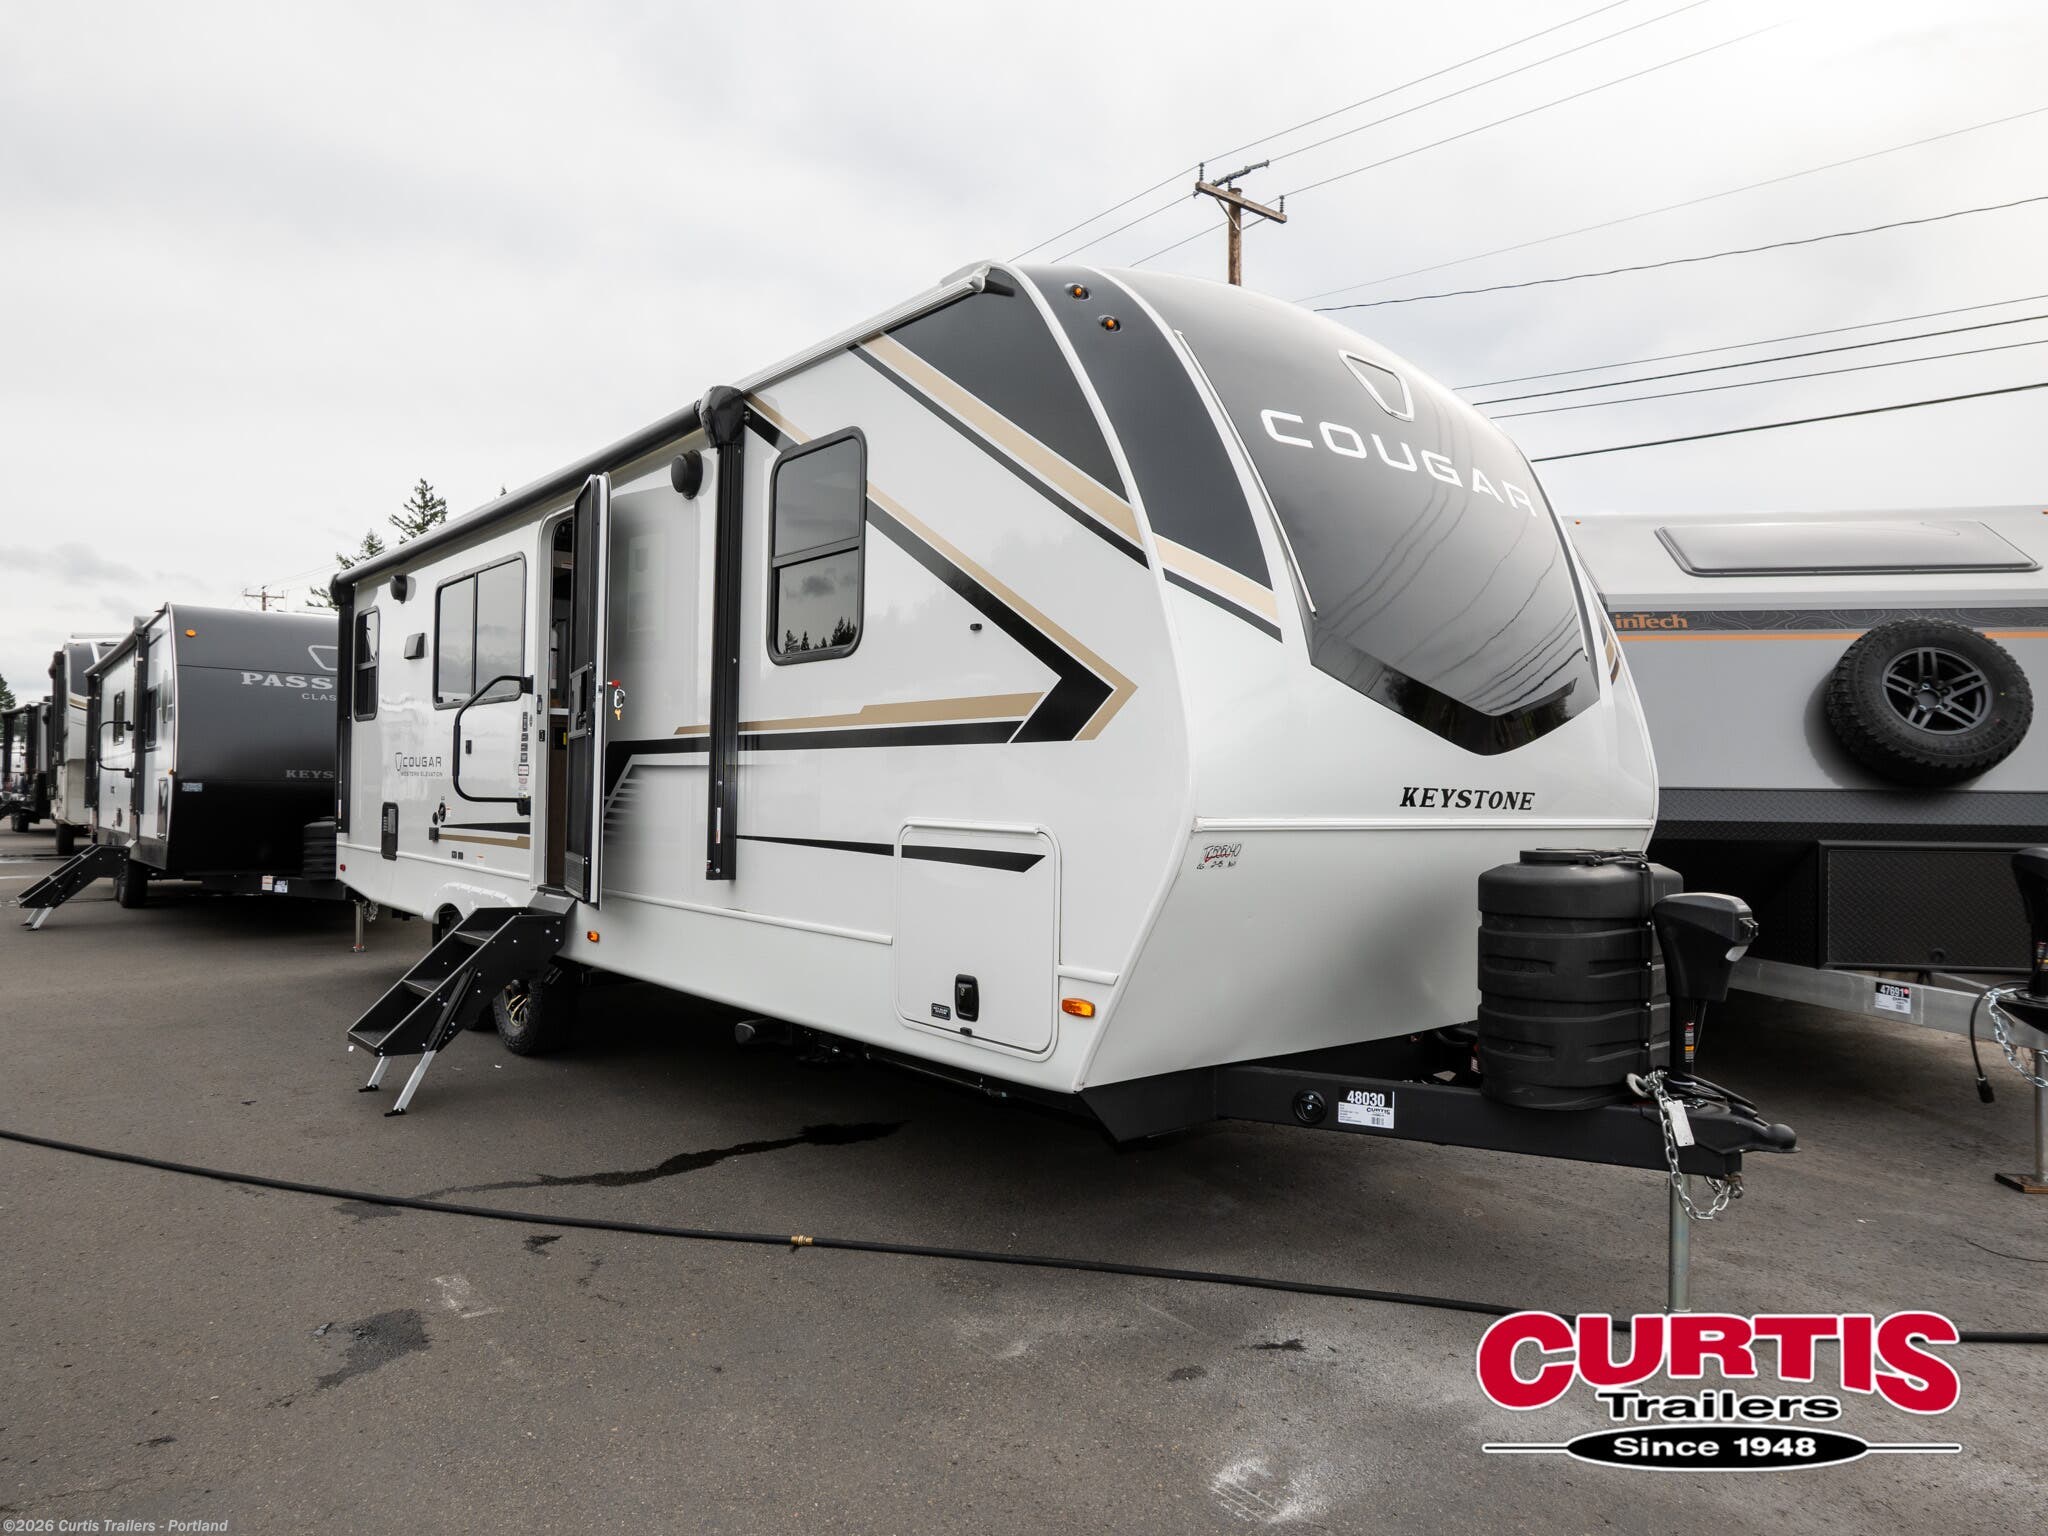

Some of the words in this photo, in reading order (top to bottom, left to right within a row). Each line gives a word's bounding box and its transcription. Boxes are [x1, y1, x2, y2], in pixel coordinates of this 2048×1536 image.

[1260, 409, 1537, 517] COUGAR
[1615, 613, 1688, 629] inTech
[403, 756, 441, 767] COUGAR
[1399, 786, 1536, 811] KEYSTONE
[1880, 984, 1904, 997] 47691
[1347, 1090, 1385, 1107] 48030
